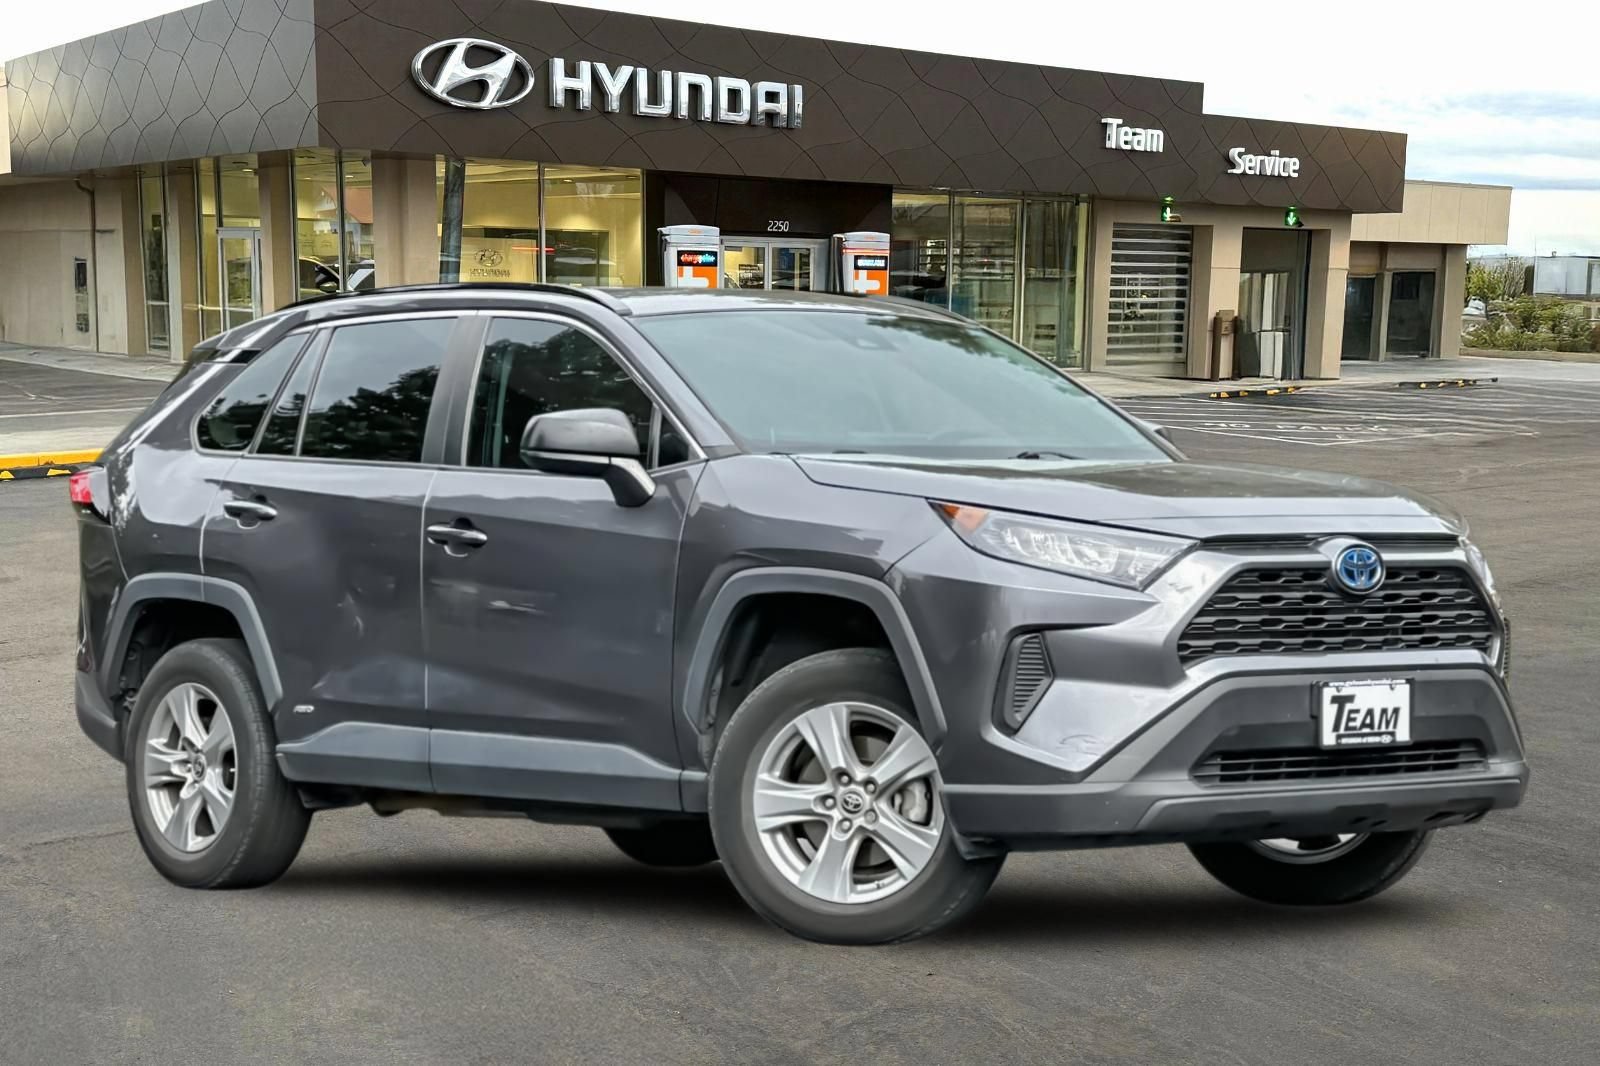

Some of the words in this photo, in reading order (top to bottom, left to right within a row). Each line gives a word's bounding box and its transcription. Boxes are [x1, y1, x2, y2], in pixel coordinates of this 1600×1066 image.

[549, 57, 803, 129] HYUNDAI
[1101, 117, 1164, 153] Team
[1227, 147, 1300, 178] Service
[767, 220, 790, 232] 2250
[1330, 694, 1400, 733] TEAM
